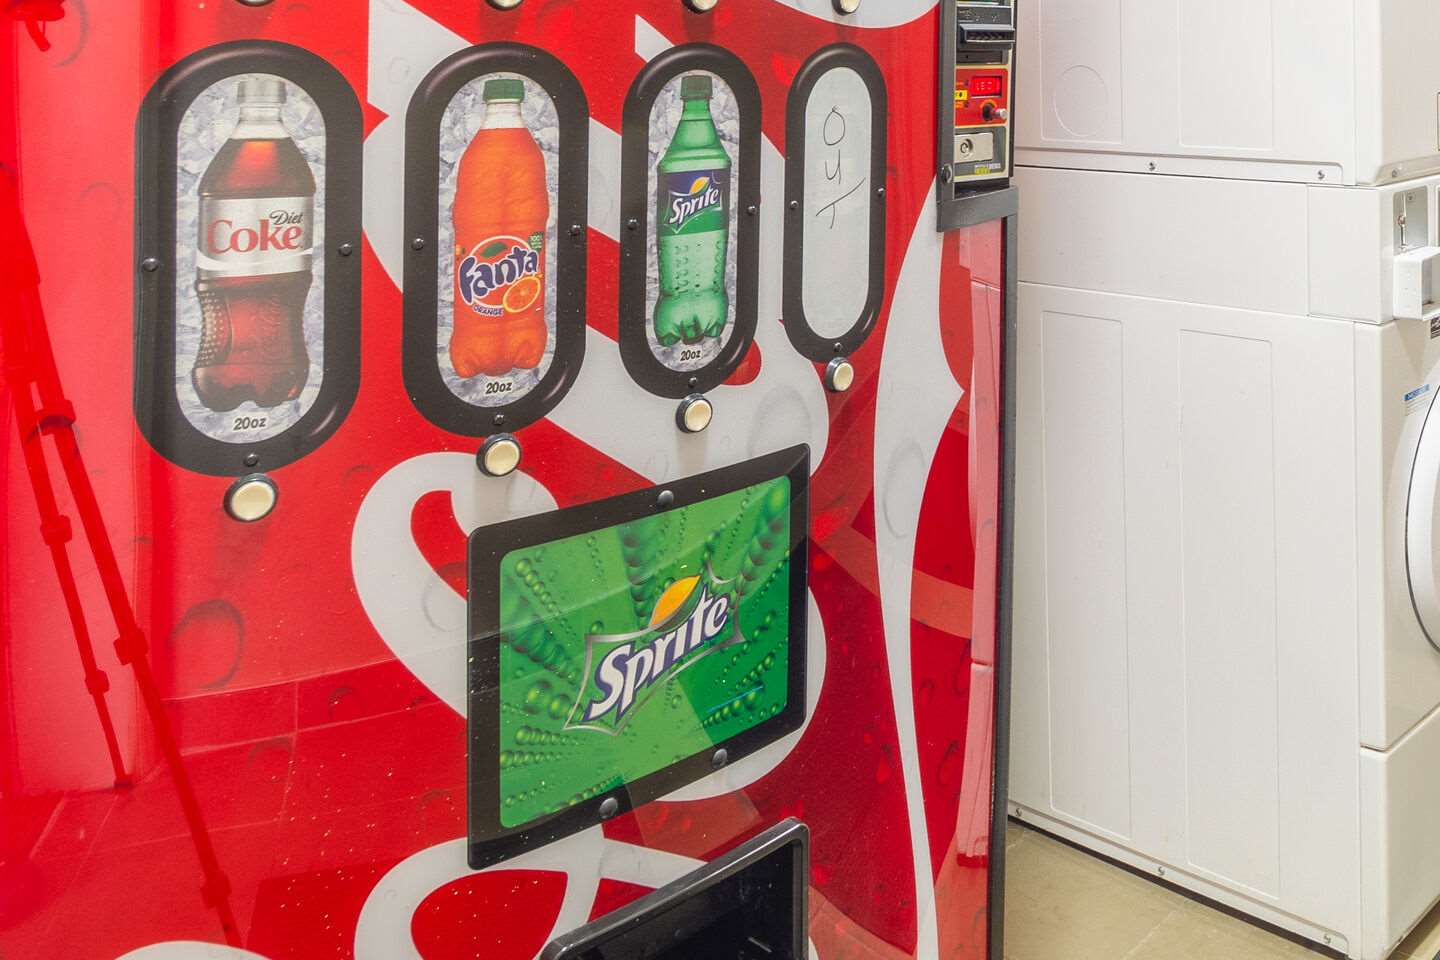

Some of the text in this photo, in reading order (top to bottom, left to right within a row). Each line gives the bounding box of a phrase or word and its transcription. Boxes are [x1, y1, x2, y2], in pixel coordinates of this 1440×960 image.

[669, 184, 719, 225] Sprite
[269, 210, 304, 225] Diet
[207, 218, 303, 254] Coke
[680, 349, 702, 362] 20oz
[484, 380, 512, 395] 20oz
[233, 416, 267, 431] 20oz
[584, 586, 730, 722] Sprite
